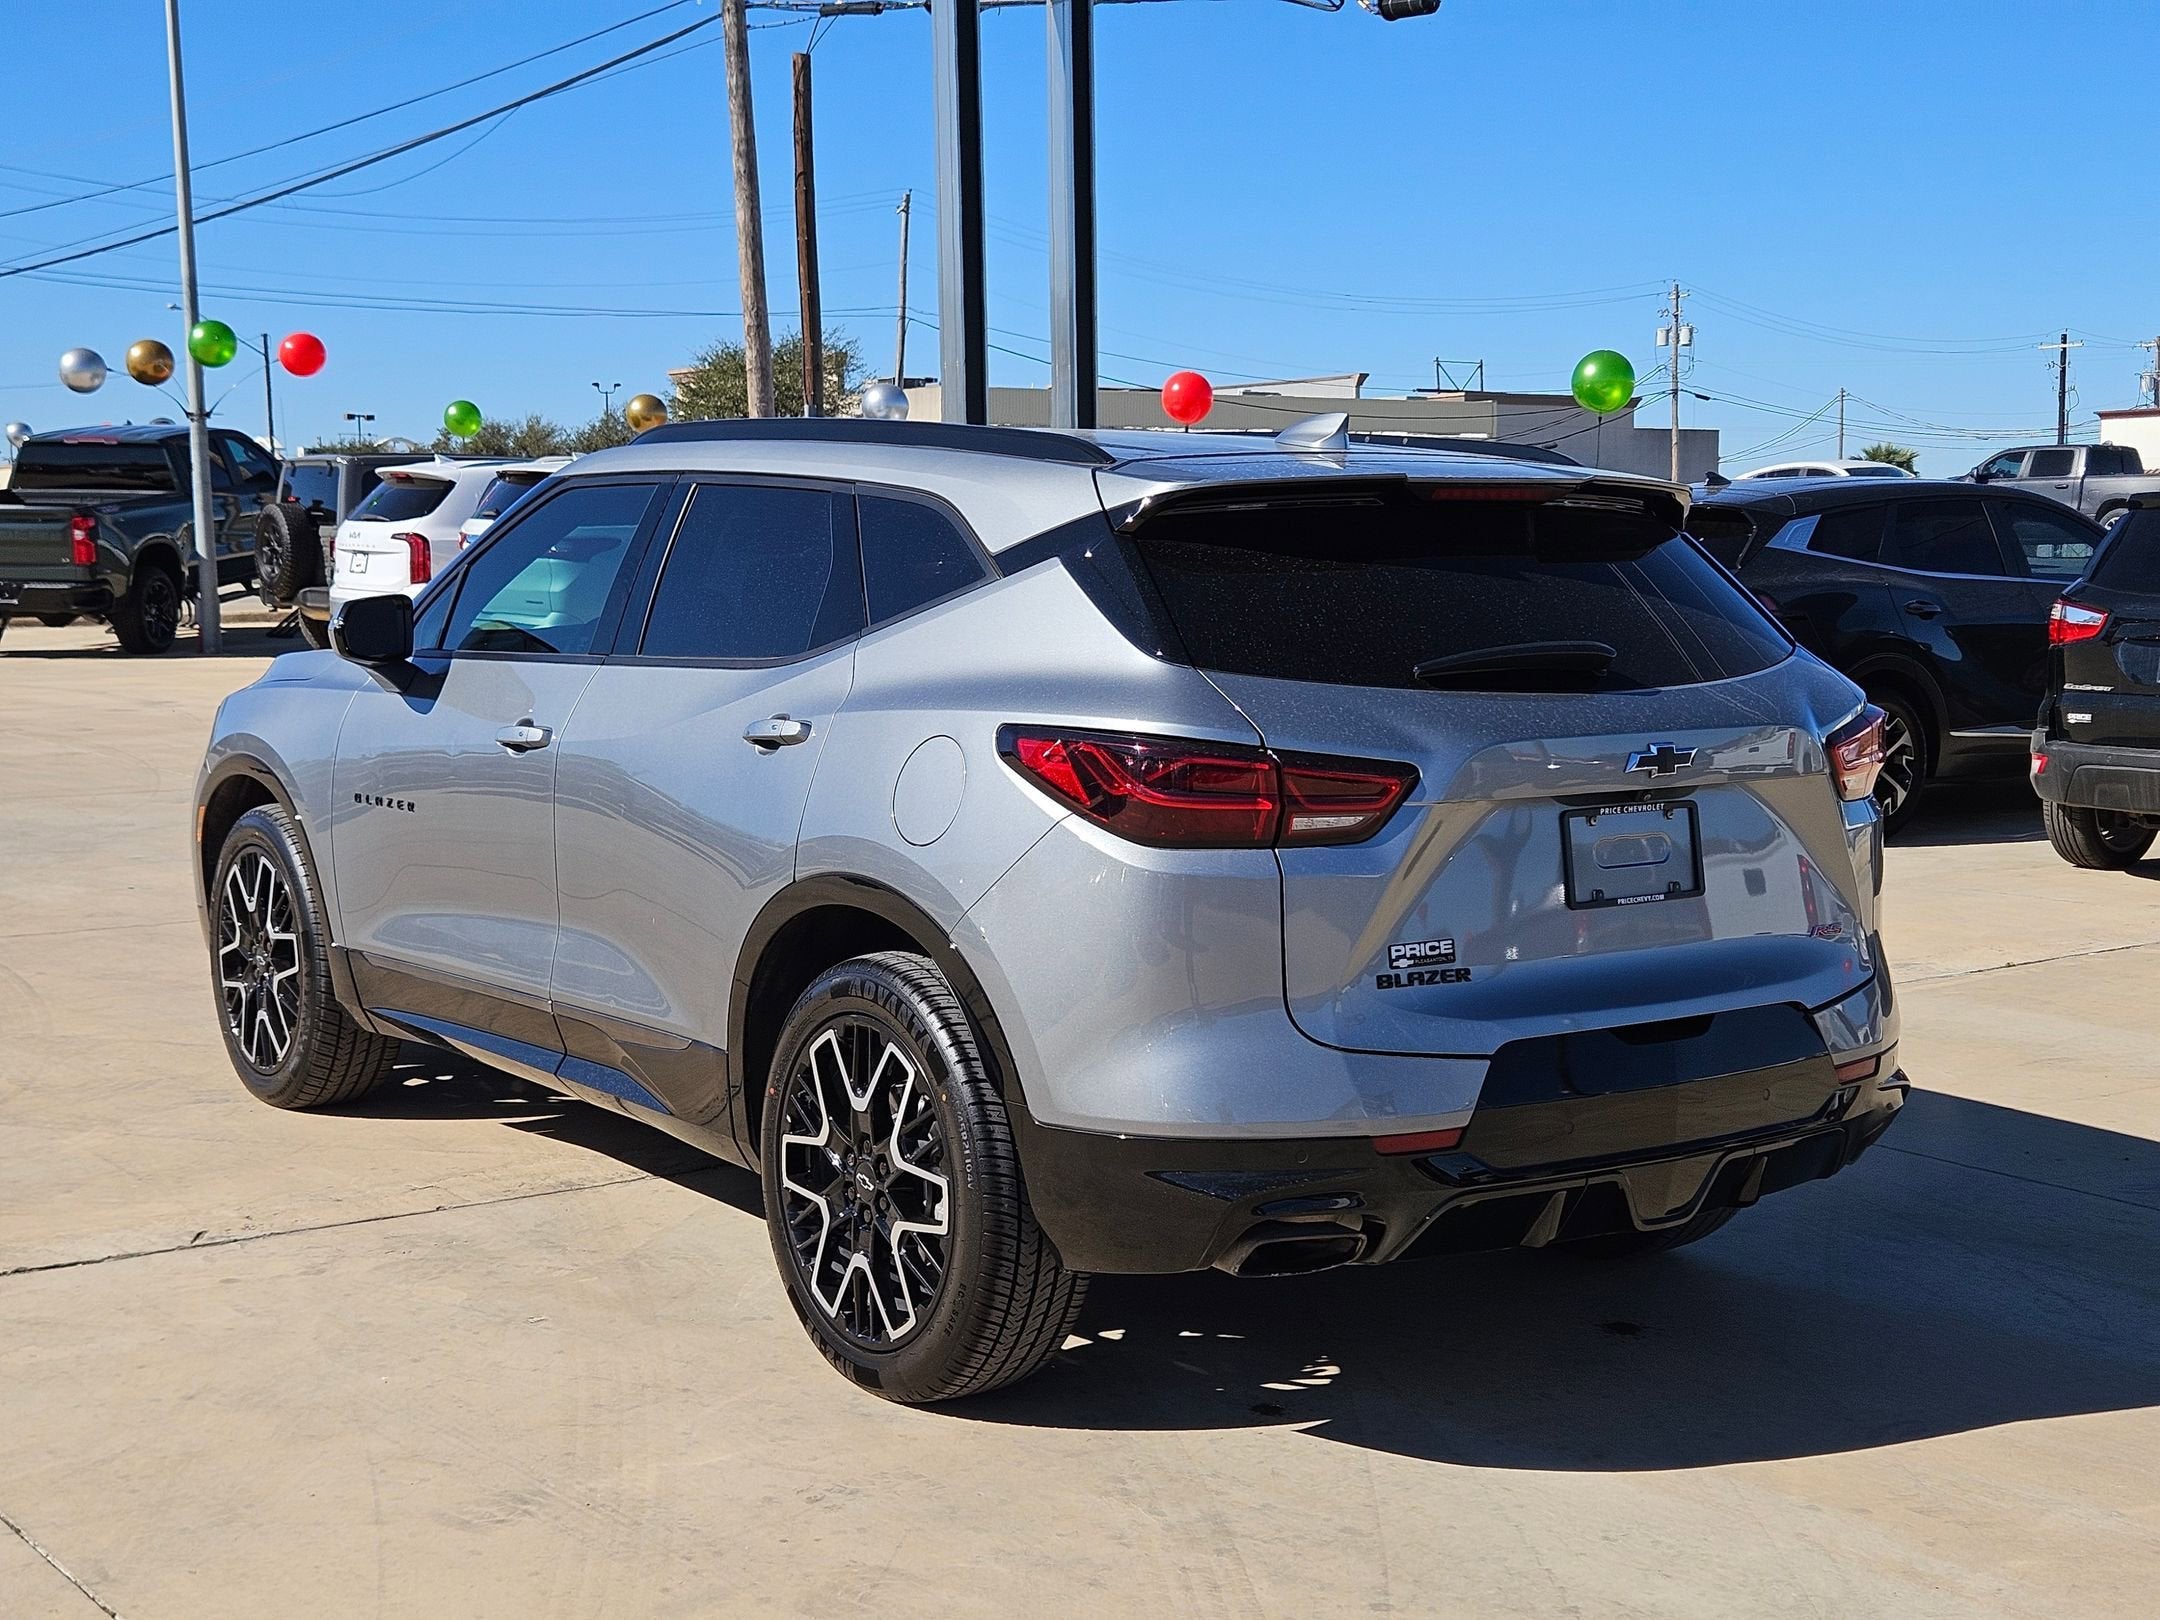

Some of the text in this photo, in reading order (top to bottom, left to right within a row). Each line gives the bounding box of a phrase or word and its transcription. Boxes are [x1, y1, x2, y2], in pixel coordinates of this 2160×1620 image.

[354, 792, 415, 813] BLAZER
[1600, 803, 1665, 815] PRICE CHEVROLET
[1617, 894, 1665, 904] PRICECHEVY.COM
[1390, 940, 1454, 960] PRICE
[1376, 967, 1473, 990] BLAZER
